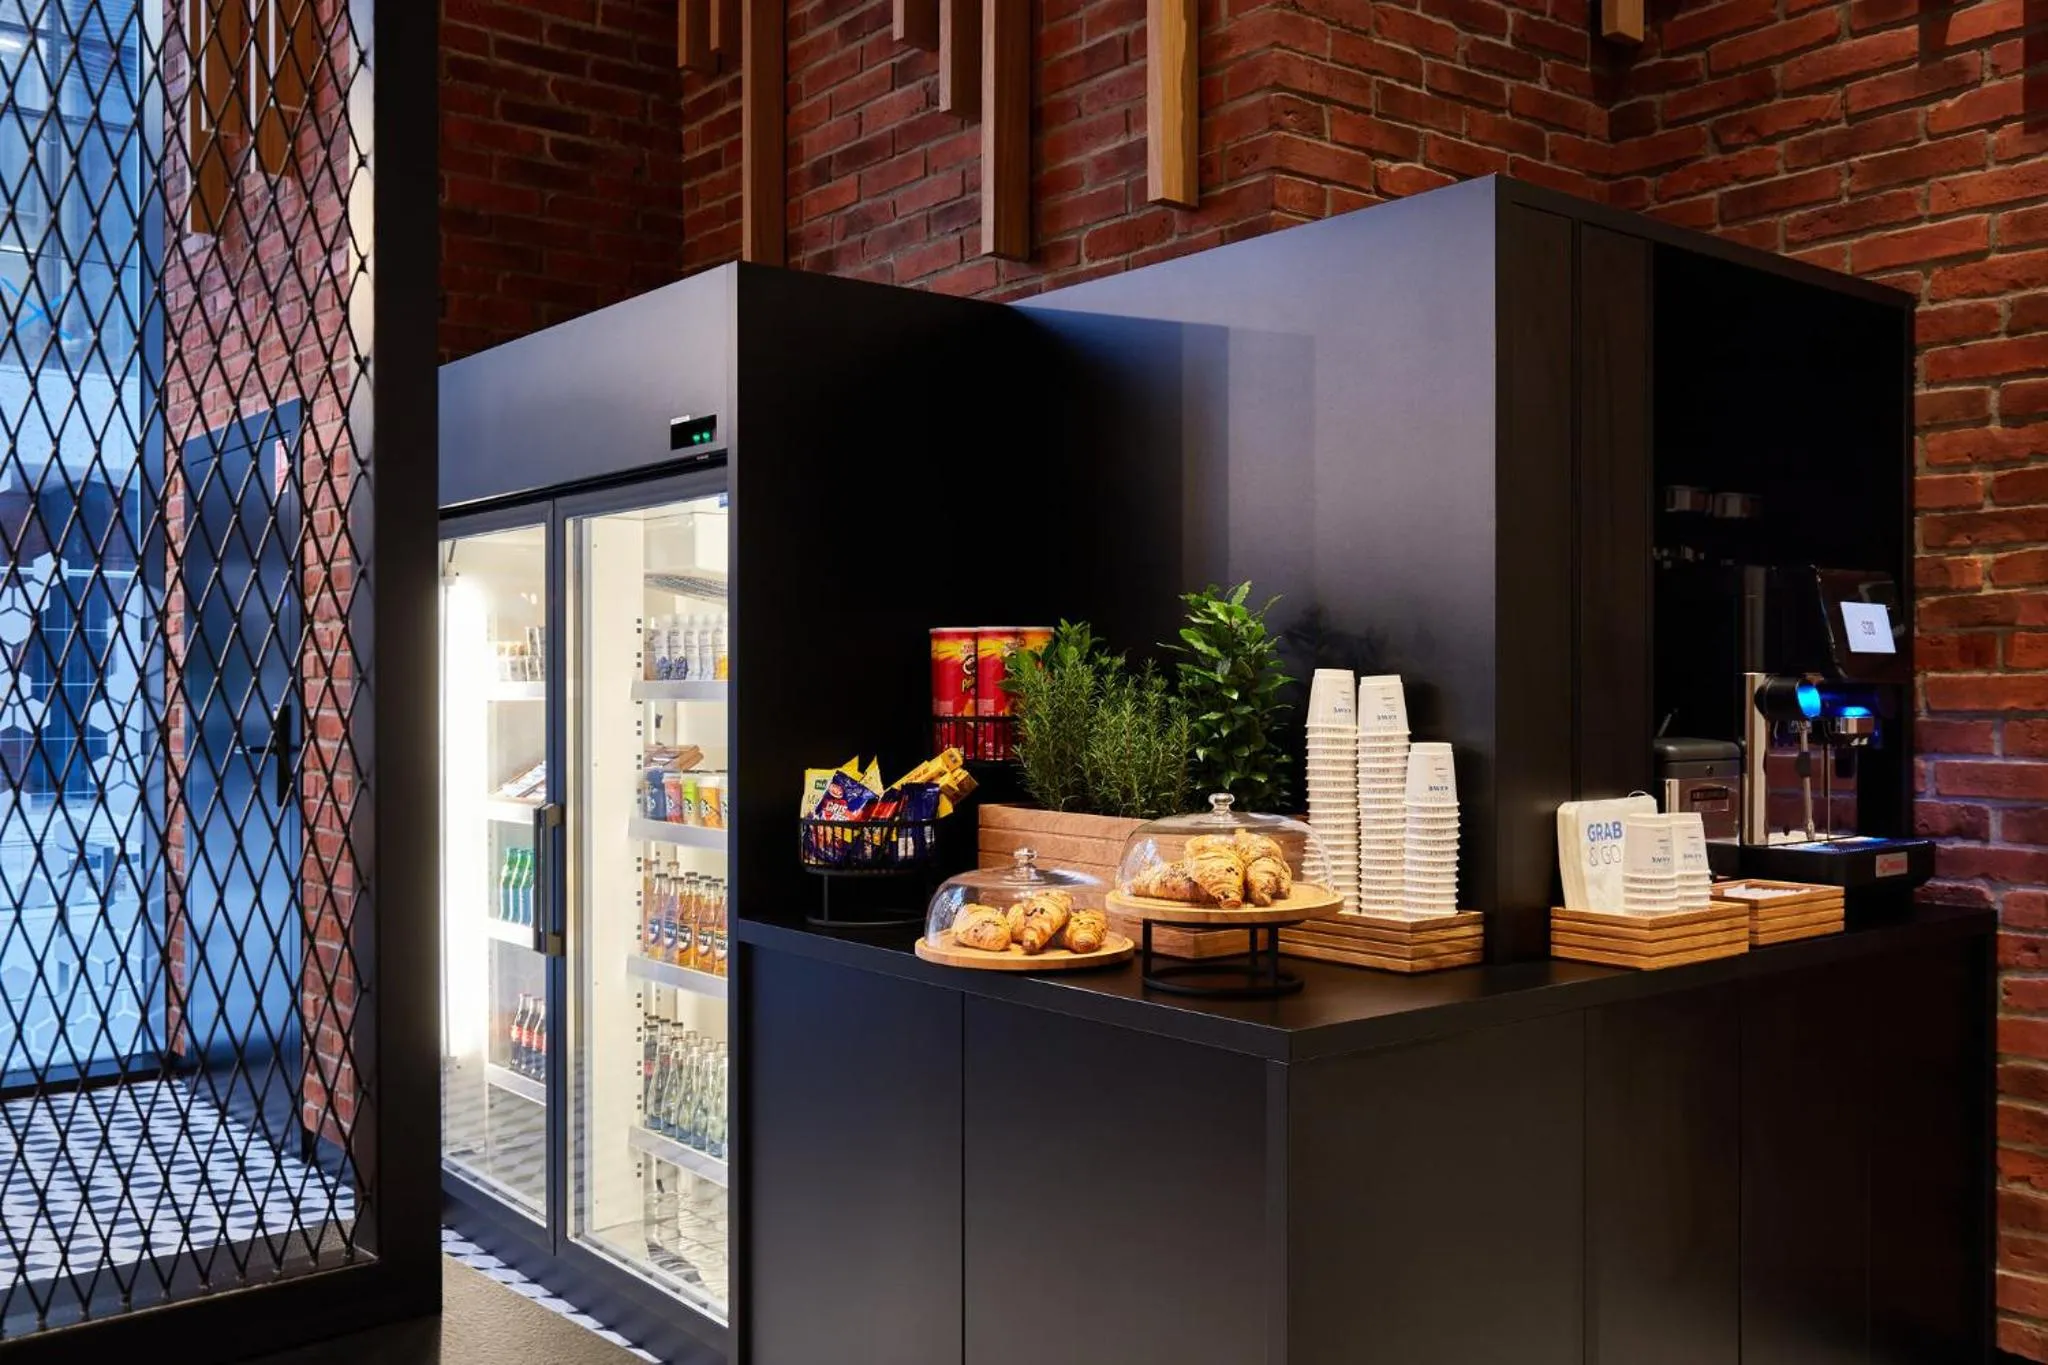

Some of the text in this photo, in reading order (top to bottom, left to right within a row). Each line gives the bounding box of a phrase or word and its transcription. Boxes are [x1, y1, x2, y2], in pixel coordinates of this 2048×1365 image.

[1588, 821, 1623, 841] GRAB
[1589, 844, 1622, 866] & GO
